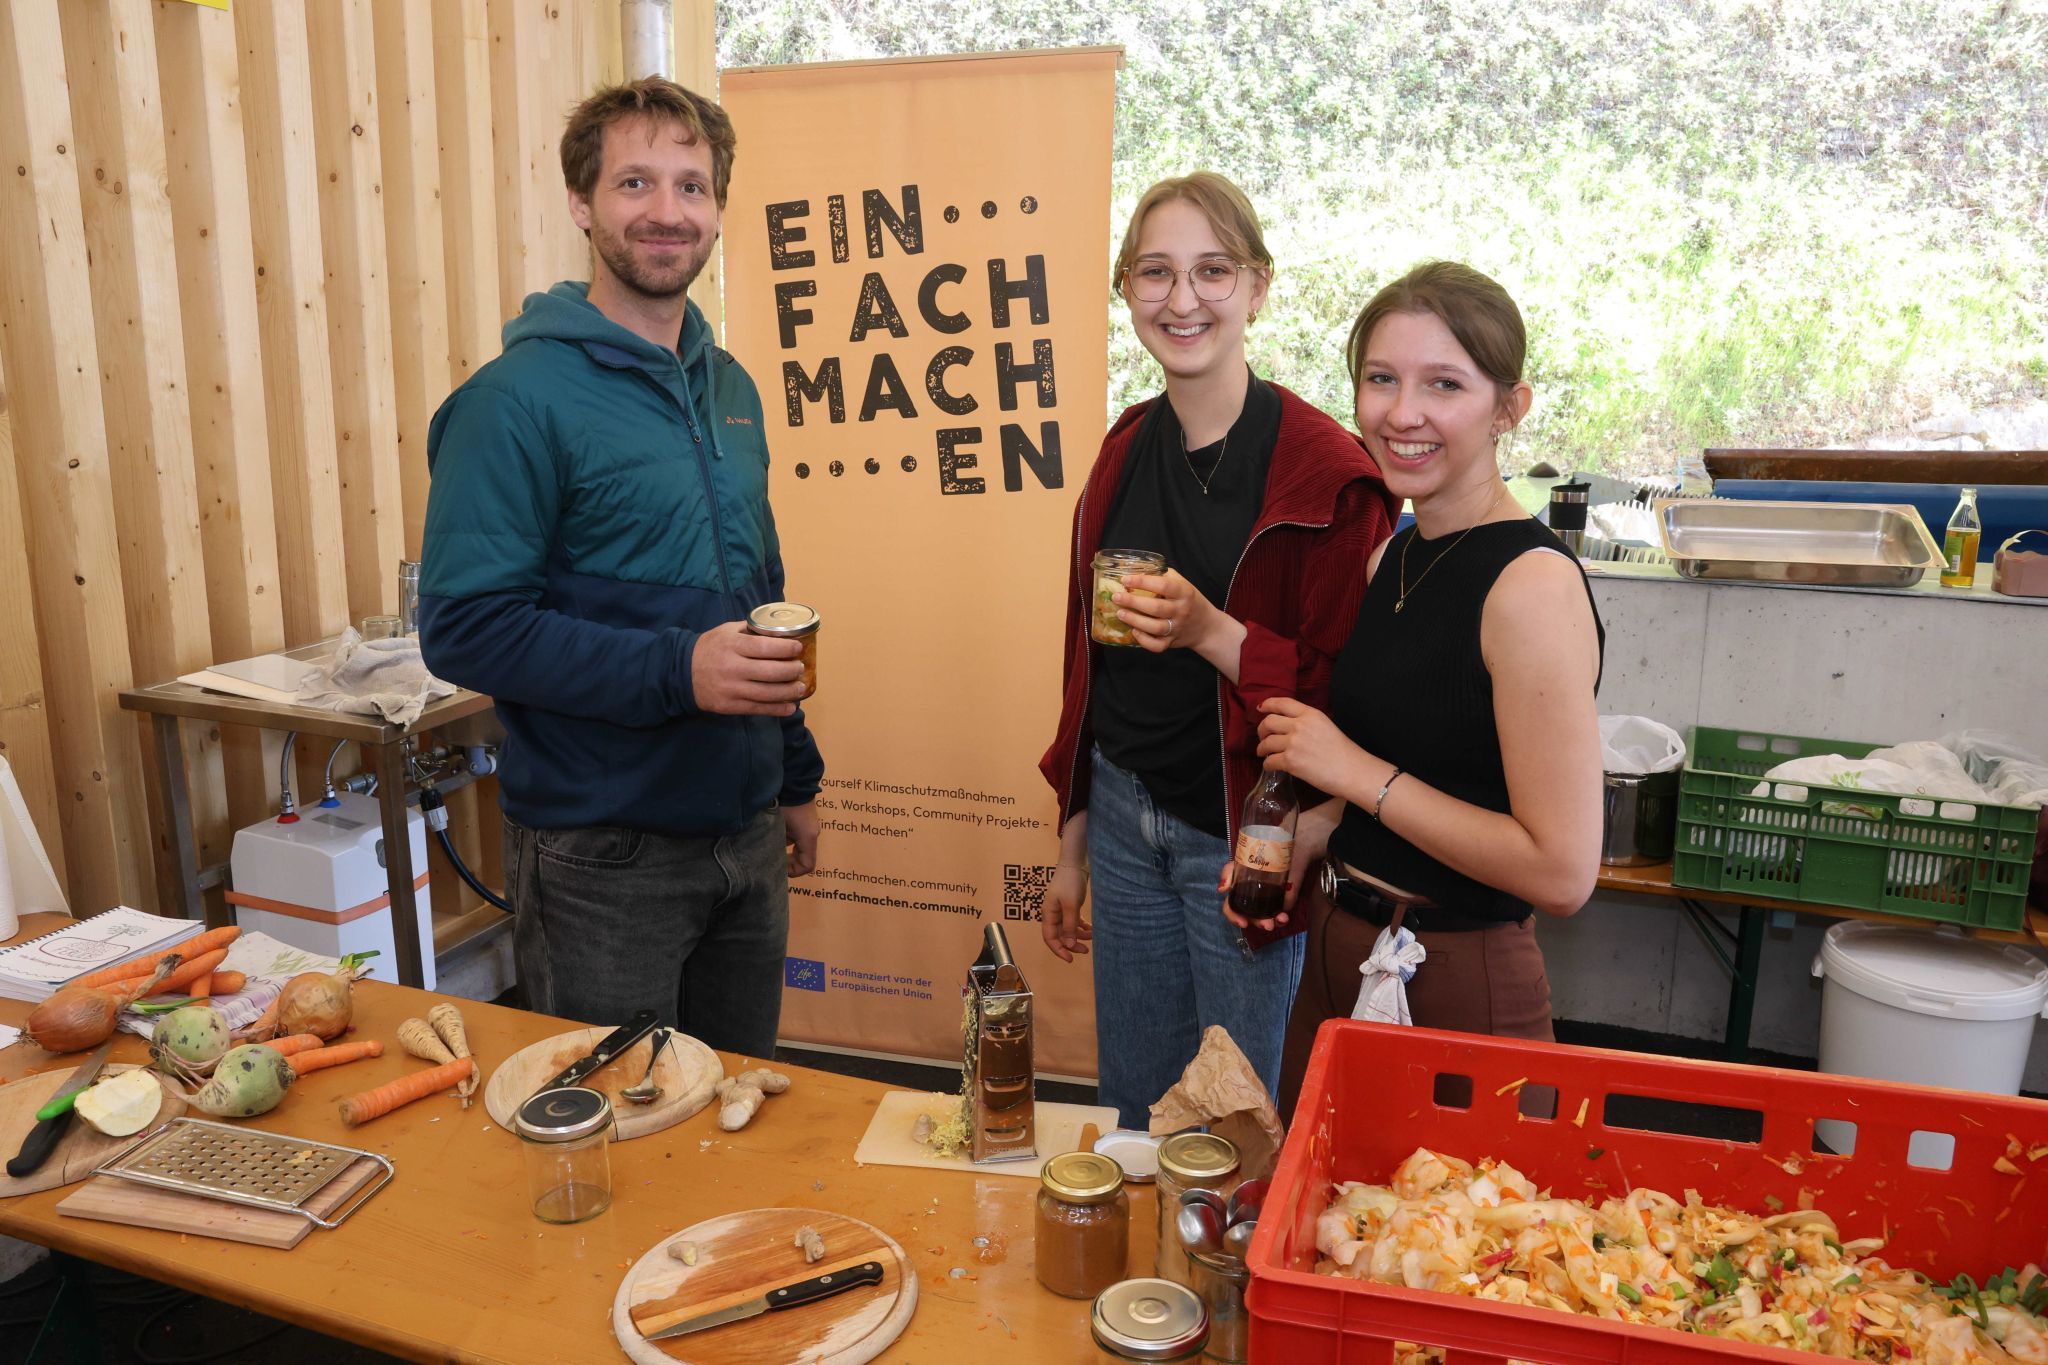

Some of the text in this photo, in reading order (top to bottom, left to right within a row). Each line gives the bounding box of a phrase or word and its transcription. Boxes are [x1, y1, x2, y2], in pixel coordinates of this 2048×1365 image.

[774, 254, 1050, 349] FACH
[782, 338, 1057, 427] MACH
[820, 778, 1015, 805] ourself Klimaschutzmaßnahmen
[818, 818, 859, 833] infach
[841, 799, 910, 818] Workshops,
[913, 806, 983, 826] Community
[986, 814, 1040, 830] Projekte
[830, 967, 933, 988] Kofinanziert von der
[831, 979, 933, 1001] Europäischen Union
